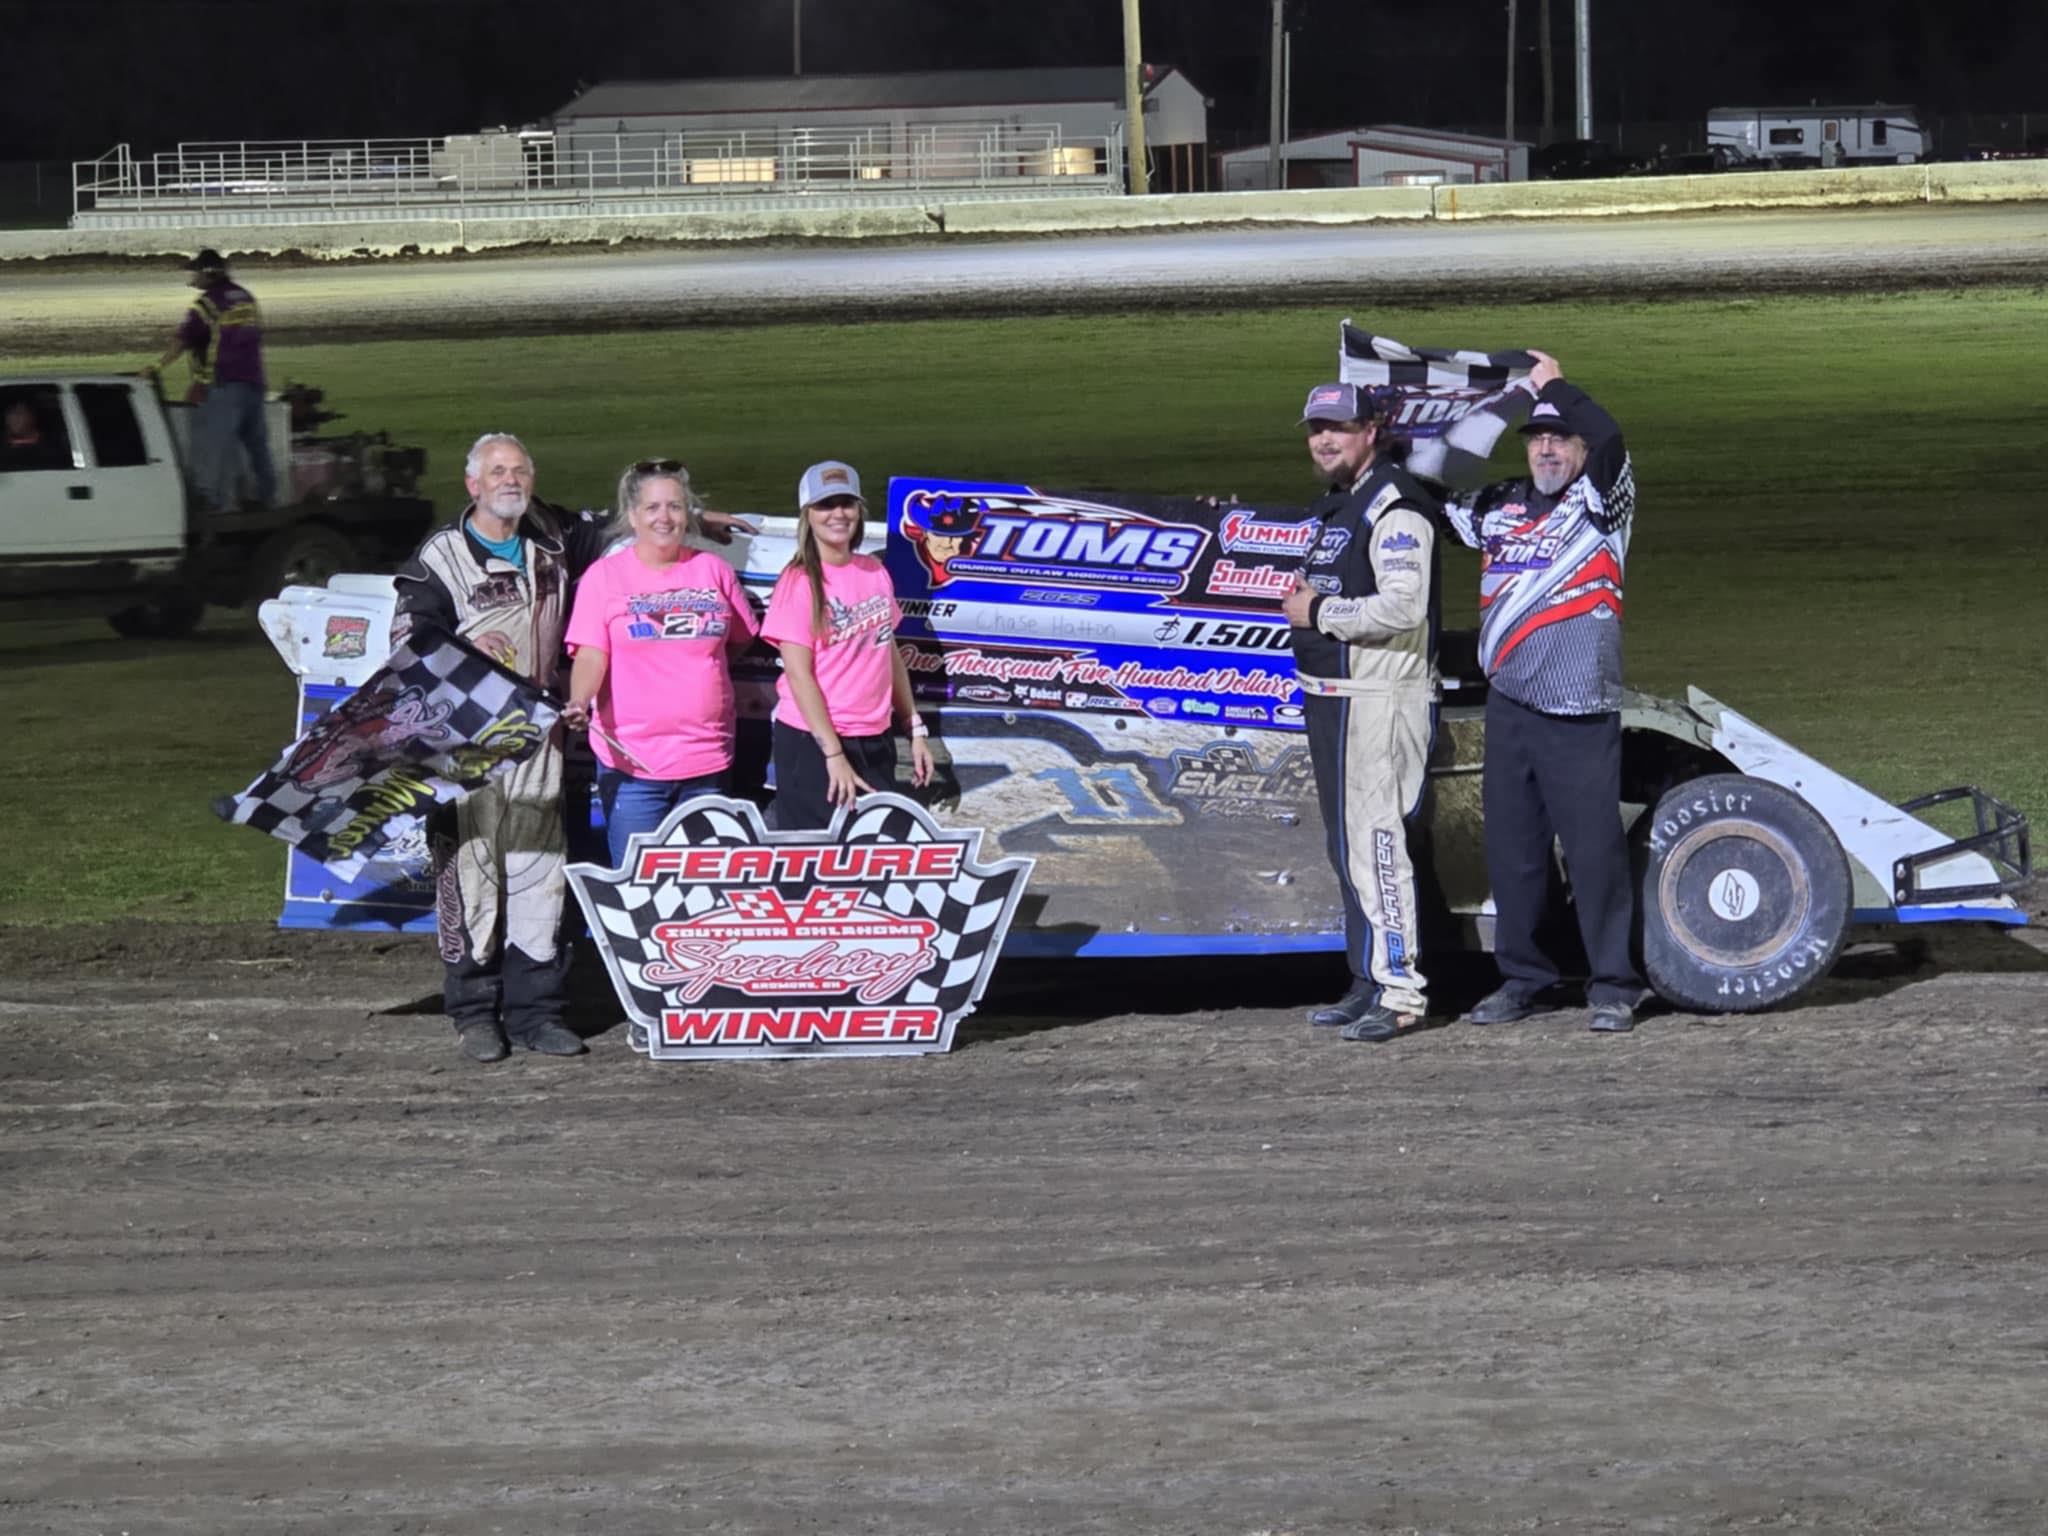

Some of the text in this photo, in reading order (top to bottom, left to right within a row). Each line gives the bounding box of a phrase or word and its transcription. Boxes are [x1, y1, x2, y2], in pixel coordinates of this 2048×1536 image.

[979, 515, 1199, 569] TOMS
[1224, 514, 1310, 545] SUMMIT
[951, 562, 1177, 585] TOURING OUTLAW MODIFIED SERIES
[1211, 560, 1297, 593] Smiley
[1020, 589, 1100, 605] 2025
[663, 613, 697, 638] 2
[976, 608, 1117, 639] Chase Hatton
[944, 648, 1063, 682] Thousand
[1062, 654, 1112, 685] Five
[1110, 661, 1213, 693] Hundred
[1213, 668, 1299, 702] Dollars
[1648, 790, 1752, 861] Hoosier
[637, 845, 963, 882] FEATURE
[1375, 829, 1401, 929] HATTER
[665, 925, 924, 939] SOUTHERN OKLAHOMA
[641, 937, 938, 1004] Speedway
[1717, 936, 1828, 999] Hoosier
[662, 1009, 941, 1041] WINNER
